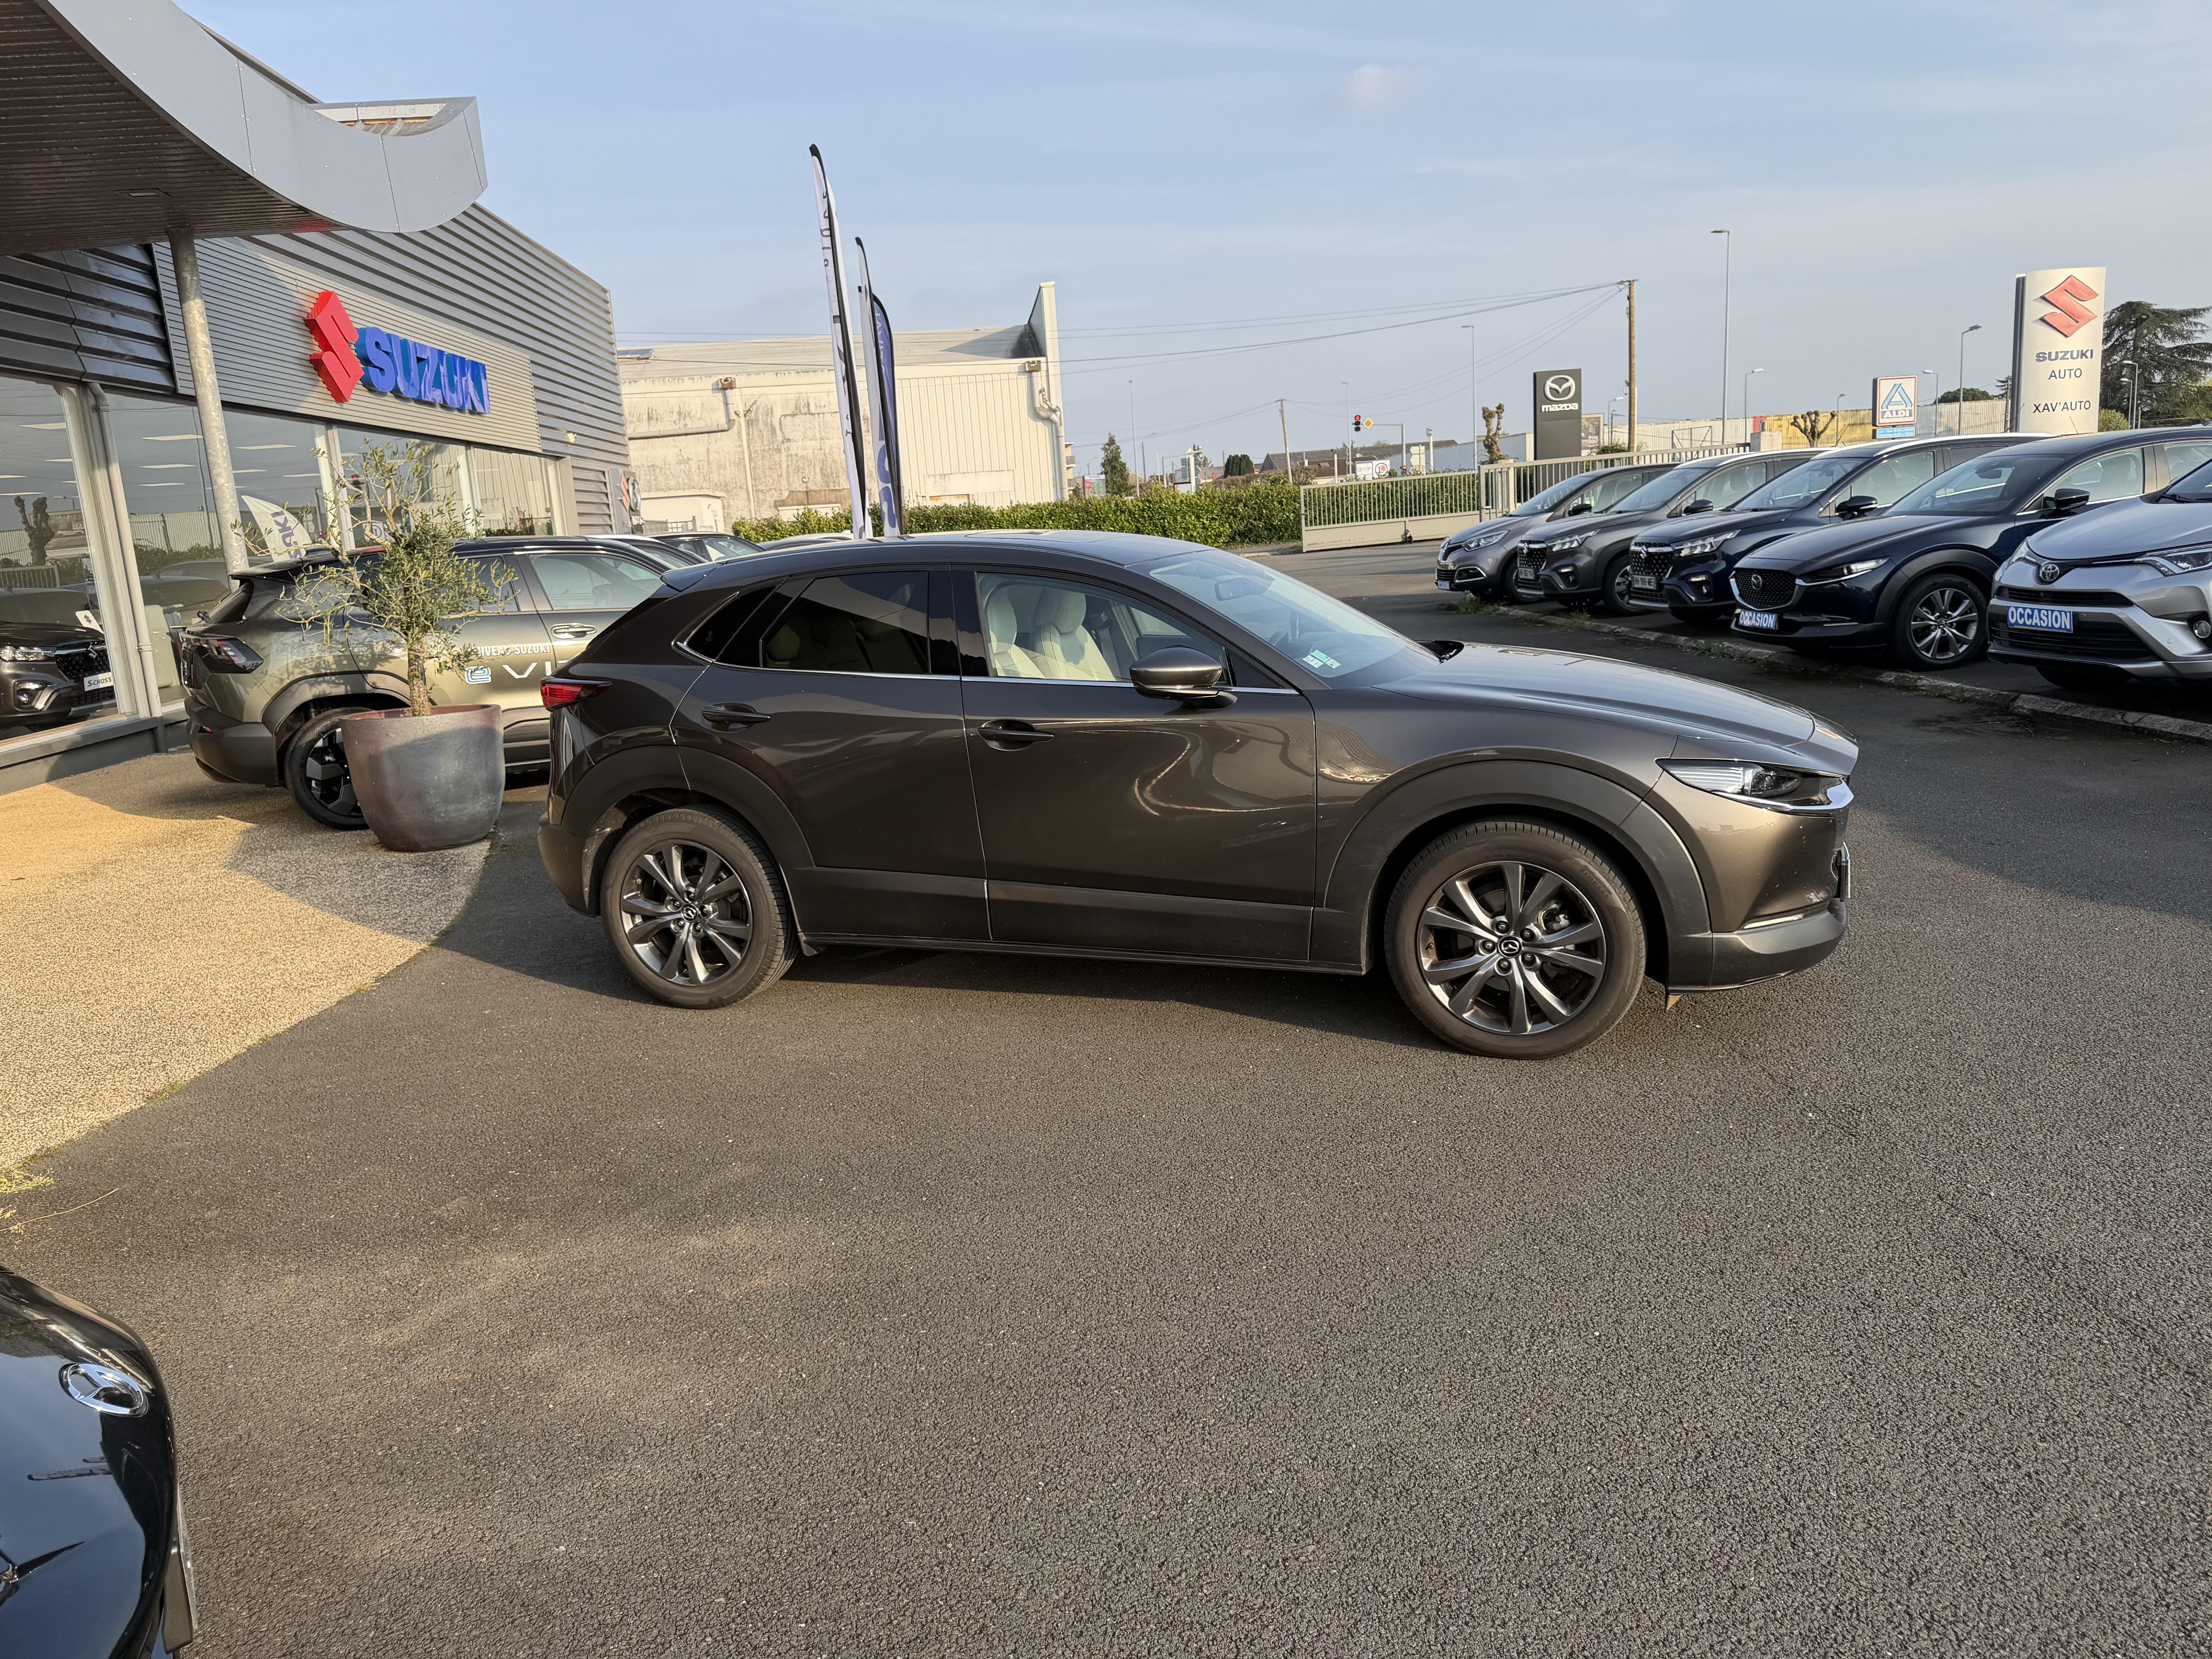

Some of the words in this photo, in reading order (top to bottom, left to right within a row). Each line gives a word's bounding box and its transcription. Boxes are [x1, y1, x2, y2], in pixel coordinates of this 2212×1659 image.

[2035, 349, 2094, 362] SUZUKI
[358, 326, 491, 414] SUZUKI
[2048, 368, 2082, 380] AUTO
[2033, 400, 2091, 413] XAV'AUTO
[1883, 409, 1910, 419] ALDI
[1739, 611, 1775, 628] OCCASION
[2008, 607, 2070, 629] OCCASION
[514, 642, 551, 655] SUZUKI
[87, 677, 113, 687] S-CROSS
